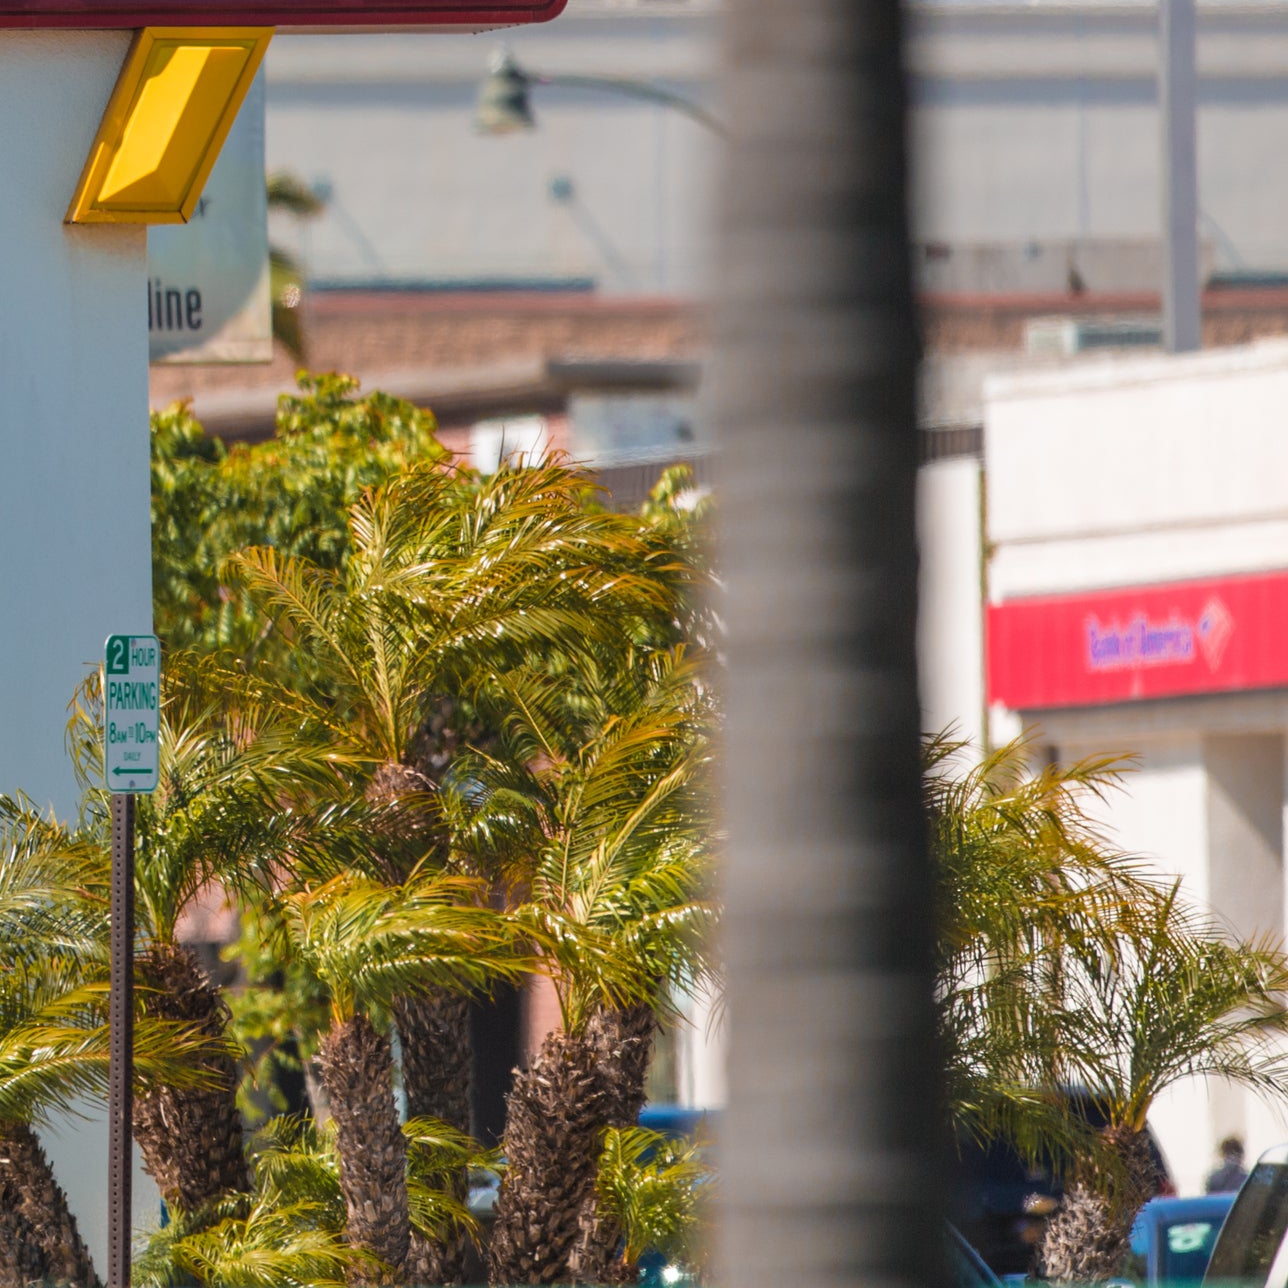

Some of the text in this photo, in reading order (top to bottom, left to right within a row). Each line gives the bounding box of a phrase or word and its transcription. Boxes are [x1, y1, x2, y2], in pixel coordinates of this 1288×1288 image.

[112, 639, 156, 670] 2 HOUR
[109, 682, 156, 710] PARKING
[109, 722, 127, 743] 8AM
[135, 722, 156, 743] 10PM
